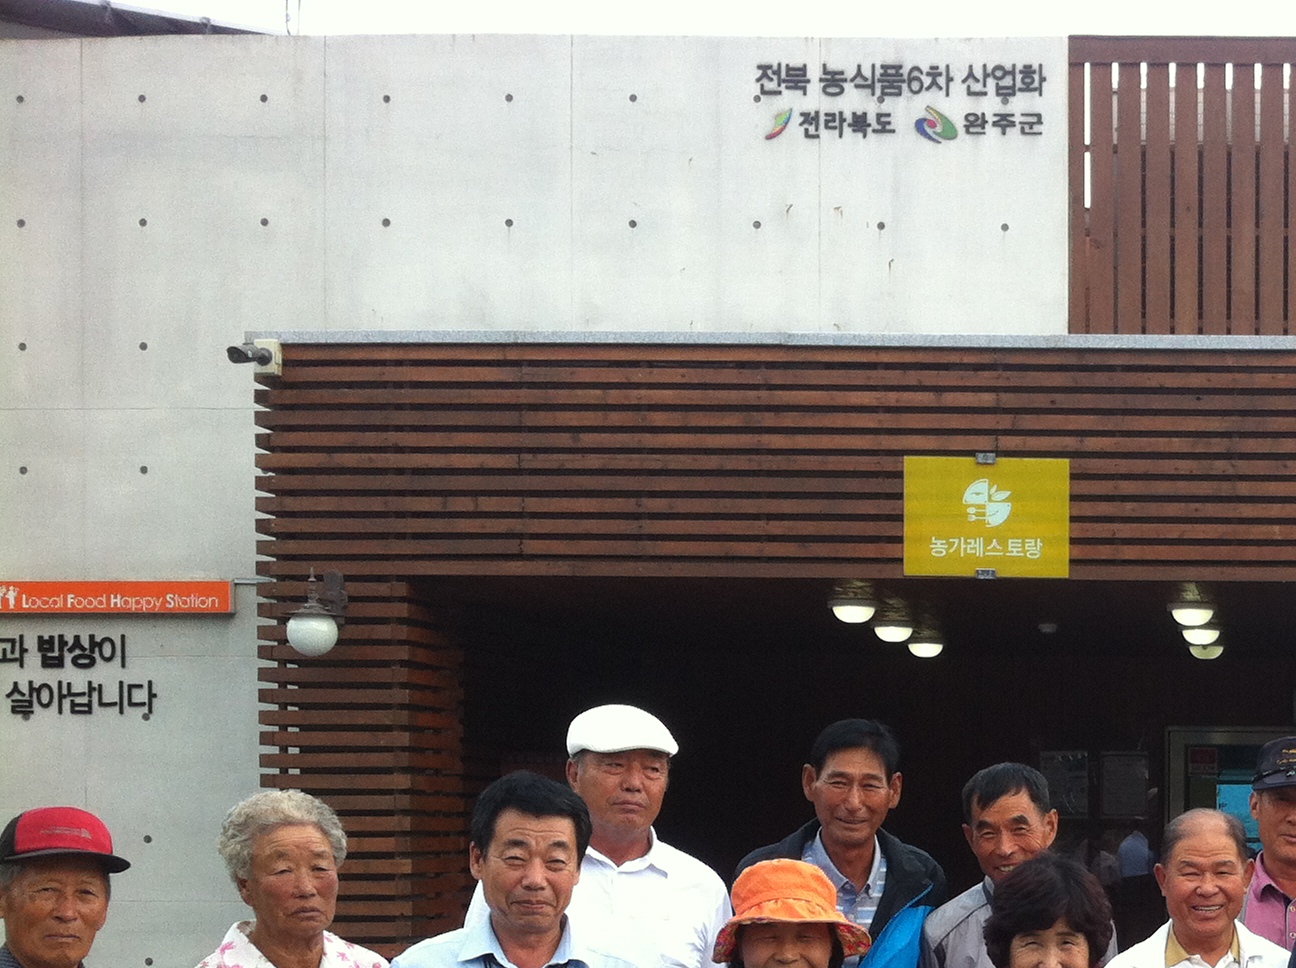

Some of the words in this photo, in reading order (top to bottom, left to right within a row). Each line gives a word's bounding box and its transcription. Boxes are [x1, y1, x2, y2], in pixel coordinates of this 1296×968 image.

[754, 61, 811, 97] 전북
[818, 61, 954, 98] 농식품6차
[960, 63, 1047, 98] 산업화
[798, 110, 896, 139] 전라북도
[962, 111, 1044, 136] 완주군
[929, 536, 1043, 560] 농가레스토랑
[21, 593, 64, 609] Local
[66, 593, 107, 609] Food
[110, 593, 163, 612] Happy
[165, 592, 219, 609] Station
[37, 633, 127, 669] 밥상이
[5, 680, 157, 716] 살아납니다
